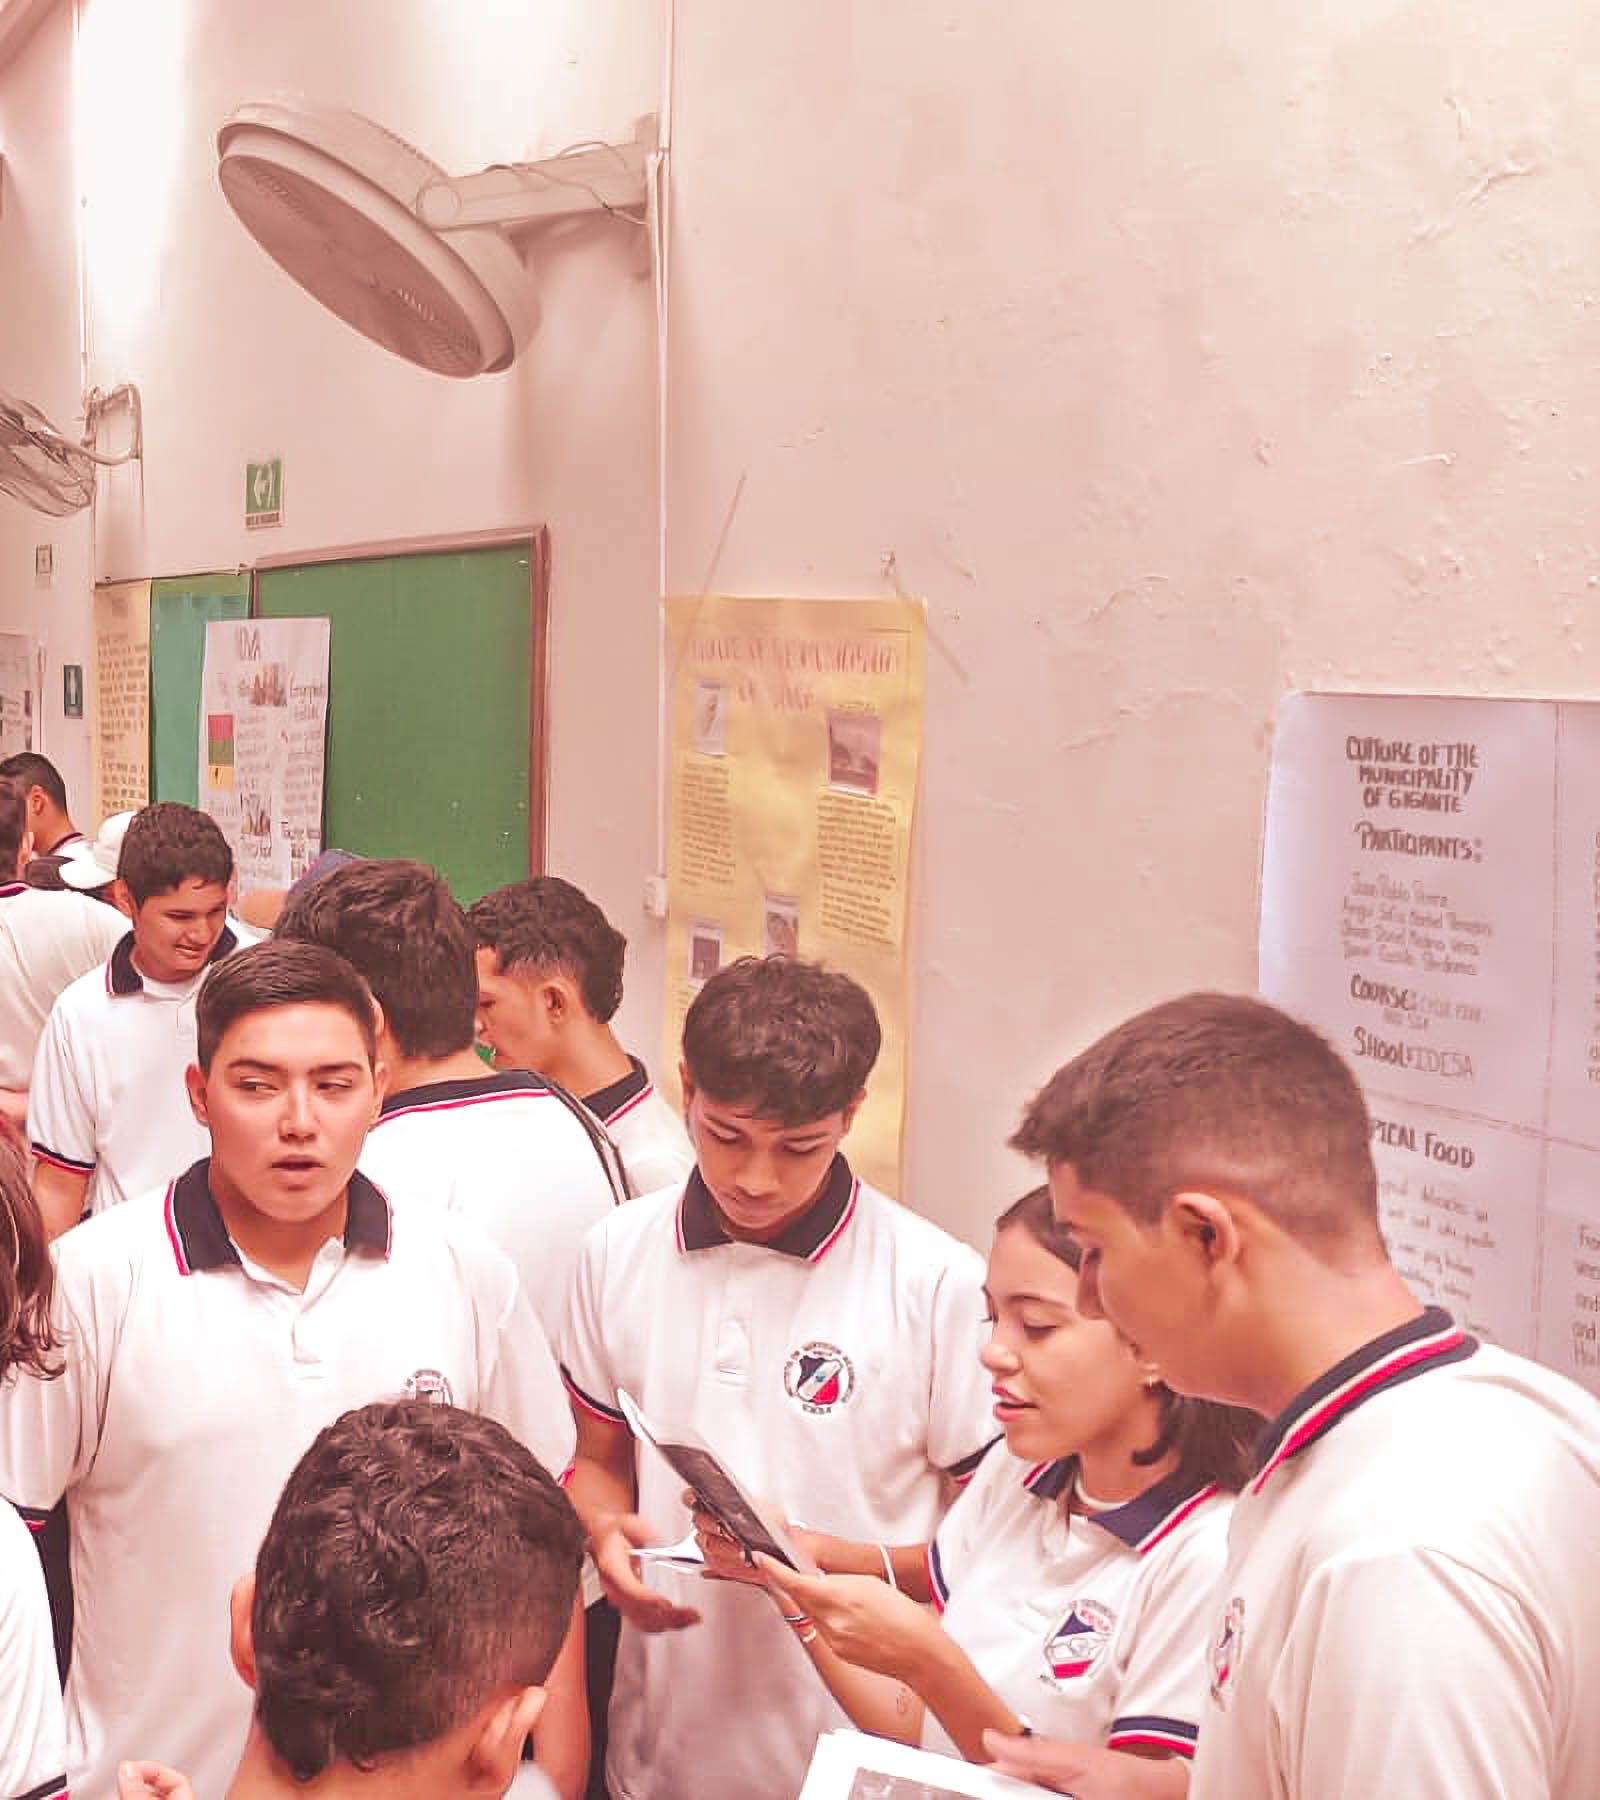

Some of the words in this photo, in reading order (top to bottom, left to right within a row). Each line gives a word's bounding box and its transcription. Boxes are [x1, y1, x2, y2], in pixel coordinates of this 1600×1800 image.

[1418, 742, 1441, 766] OF
[1440, 744, 1480, 768] THE
[1363, 786, 1386, 808] OF
[1389, 789, 1464, 813] GIGANTE
[1424, 1132, 1476, 1169] FOOD
